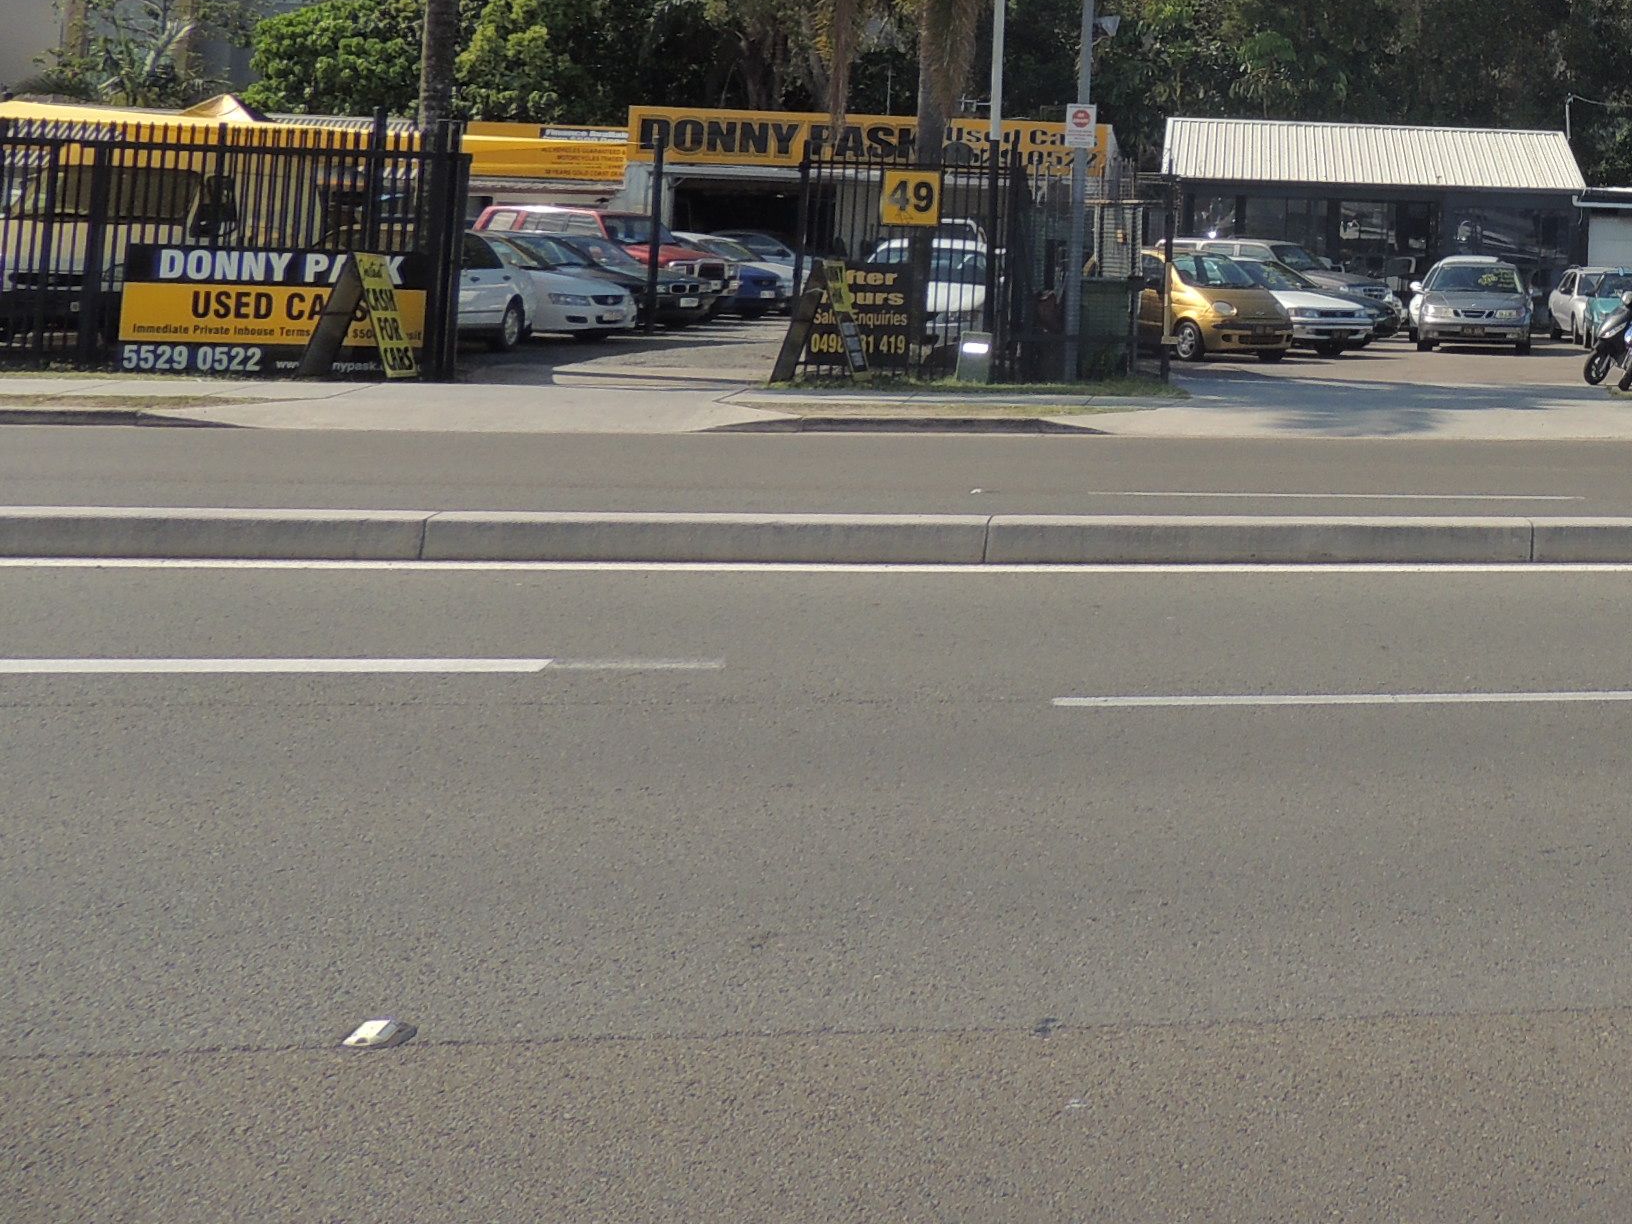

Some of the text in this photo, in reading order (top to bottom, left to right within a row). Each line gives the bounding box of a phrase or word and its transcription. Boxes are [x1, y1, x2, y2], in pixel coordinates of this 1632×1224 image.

[639, 117, 799, 155] DONNY
[888, 180, 934, 213] 49
[159, 249, 293, 282] DONNY
[191, 290, 273, 319] USED
[366, 288, 398, 312] CASH
[132, 323, 189, 335] Immediate
[193, 324, 230, 336] Private
[234, 325, 275, 336] Inhouse
[279, 326, 311, 337] Terms
[377, 316, 404, 341] FOR
[122, 343, 188, 370] 5529
[196, 346, 262, 371] 0522
[879, 335, 906, 354] 419
[384, 346, 415, 371] CARS
